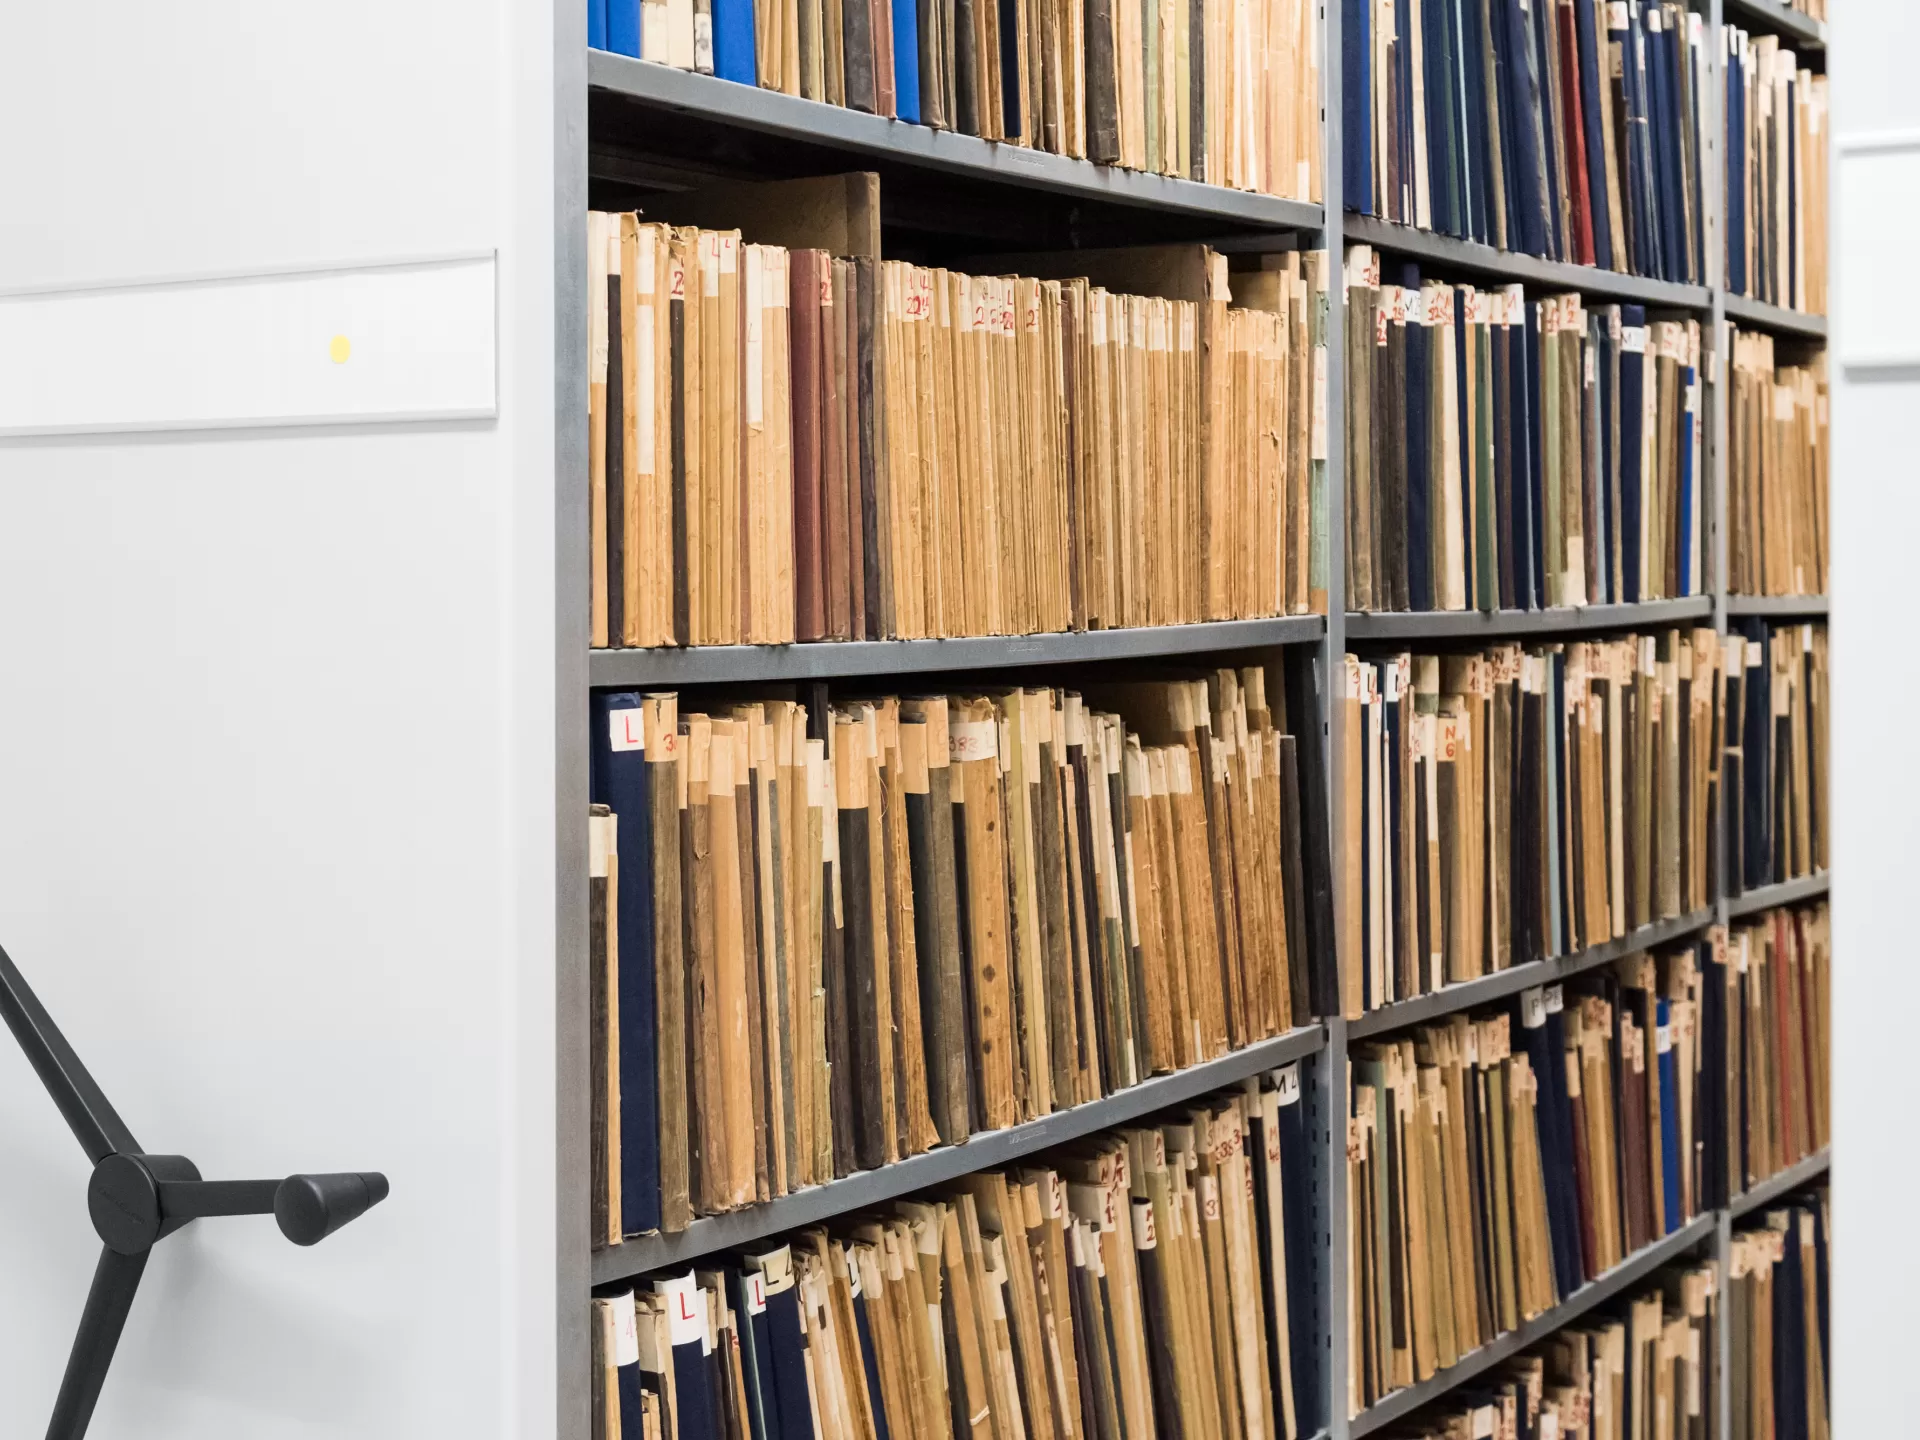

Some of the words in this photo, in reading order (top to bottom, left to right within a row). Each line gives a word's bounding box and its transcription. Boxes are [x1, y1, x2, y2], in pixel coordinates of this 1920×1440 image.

[711, 237, 720, 257] L
[725, 238, 731, 248] L
[973, 306, 985, 326] 2
[1495, 650, 1505, 665] N
[625, 715, 638, 744] L
[1445, 725, 1456, 740] N
[1446, 743, 1455, 757] 6
[1269, 1074, 1286, 1095] M
[1206, 1200, 1216, 1216] 3
[1147, 1225, 1155, 1241] 2
[762, 1260, 779, 1286] L
[848, 1262, 857, 1287] L
[755, 1279, 765, 1306] L
[679, 1292, 695, 1320] L
